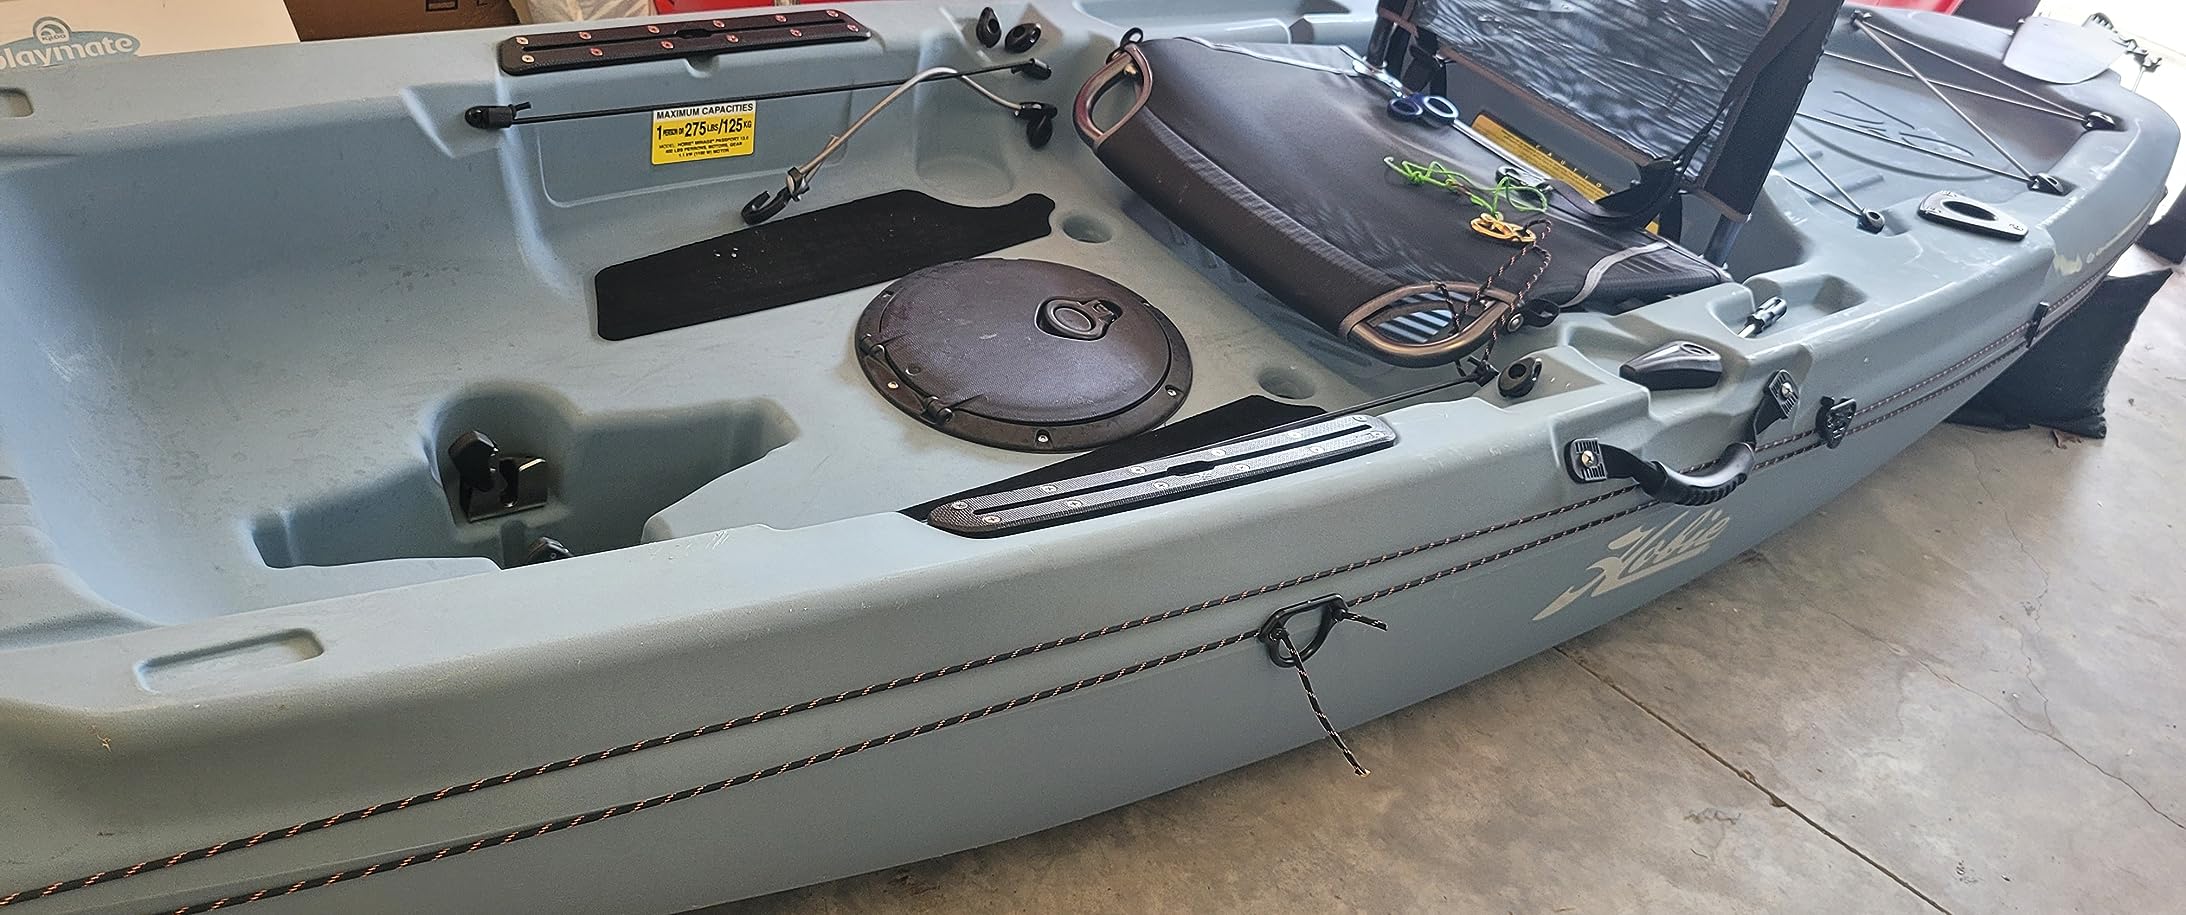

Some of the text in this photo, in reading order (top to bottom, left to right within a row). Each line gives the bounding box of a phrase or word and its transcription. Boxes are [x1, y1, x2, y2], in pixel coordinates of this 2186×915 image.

[656, 103, 754, 119] MAXIMUM CAPACITIES
[656, 125, 662, 140] 1
